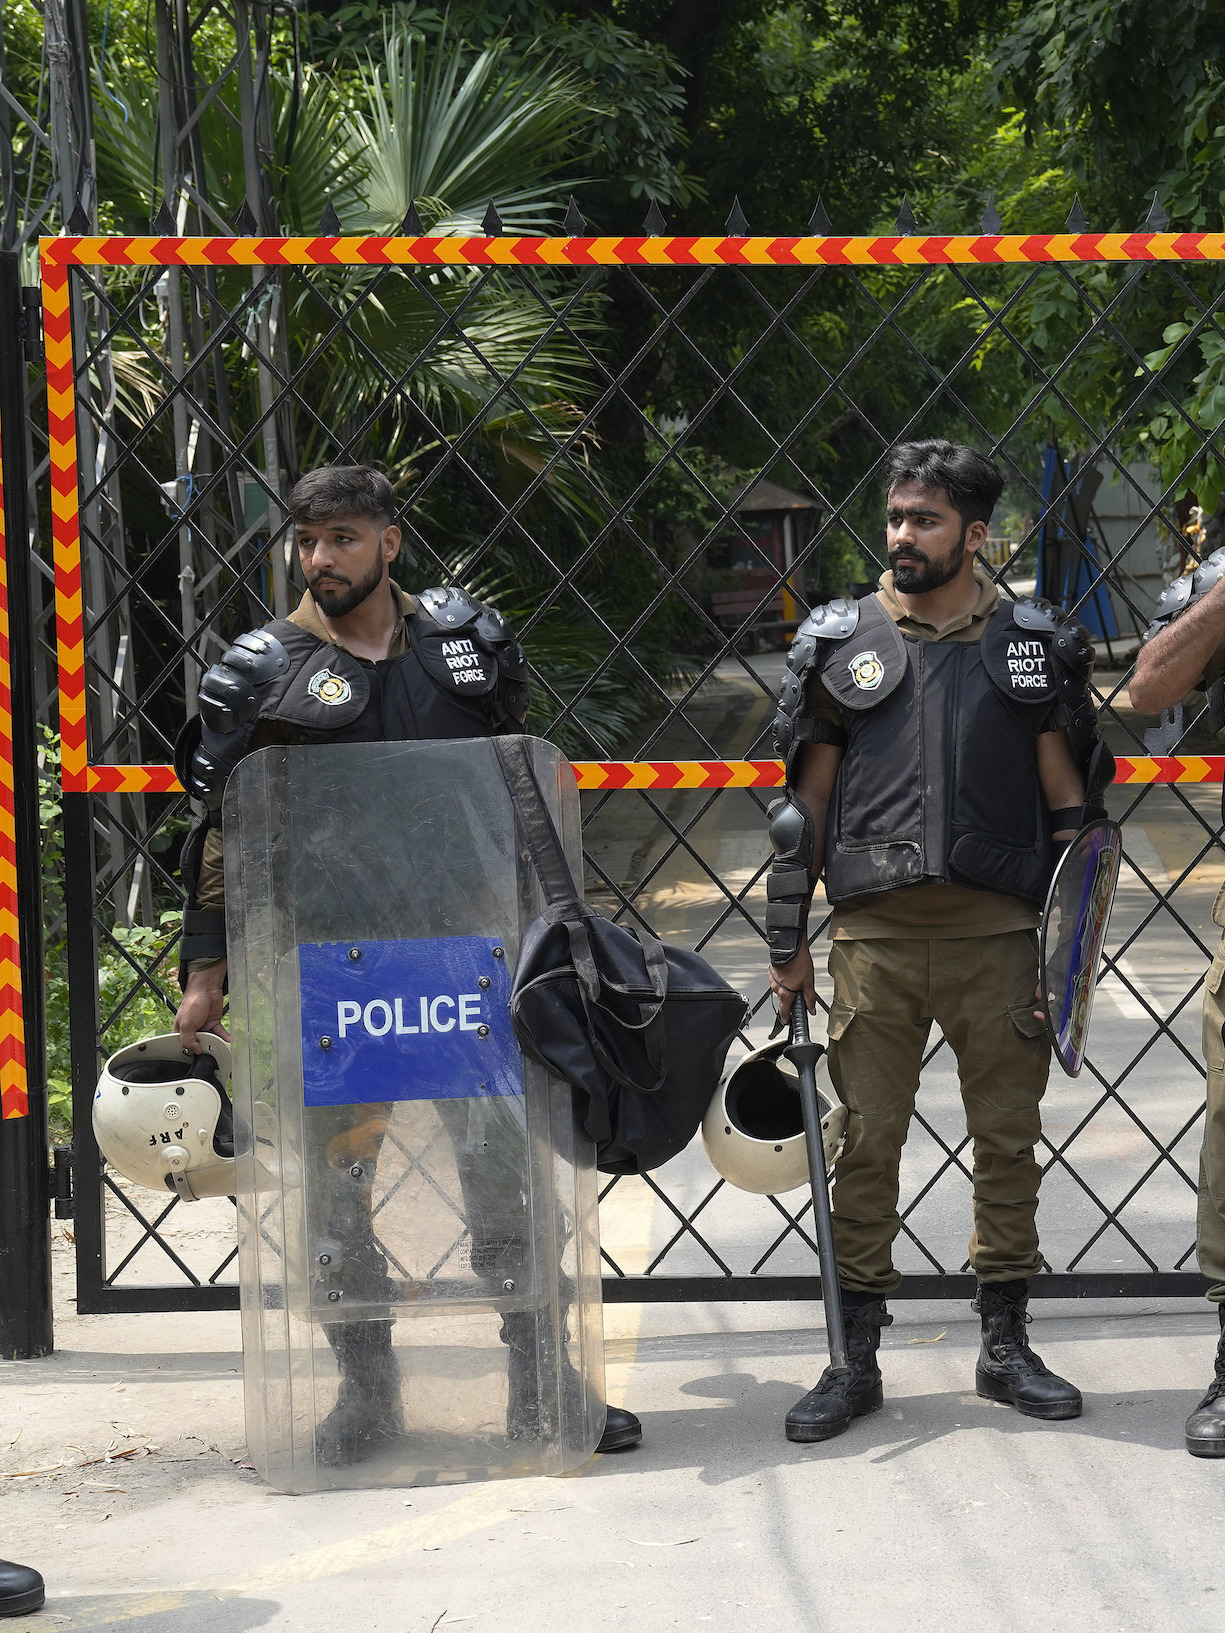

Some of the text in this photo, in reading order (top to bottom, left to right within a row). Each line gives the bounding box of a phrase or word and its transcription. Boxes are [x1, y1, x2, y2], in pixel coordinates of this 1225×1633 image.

[442, 639, 474, 655] ANTI
[1007, 641, 1044, 656] ANTI
[446, 654, 479, 669] RIOT
[1008, 658, 1046, 672] RIOT
[452, 669, 486, 685] FORCE
[1011, 674, 1048, 688] FORCE
[337, 993, 483, 1038] POLICE
[149, 1128, 184, 1146] ARF
